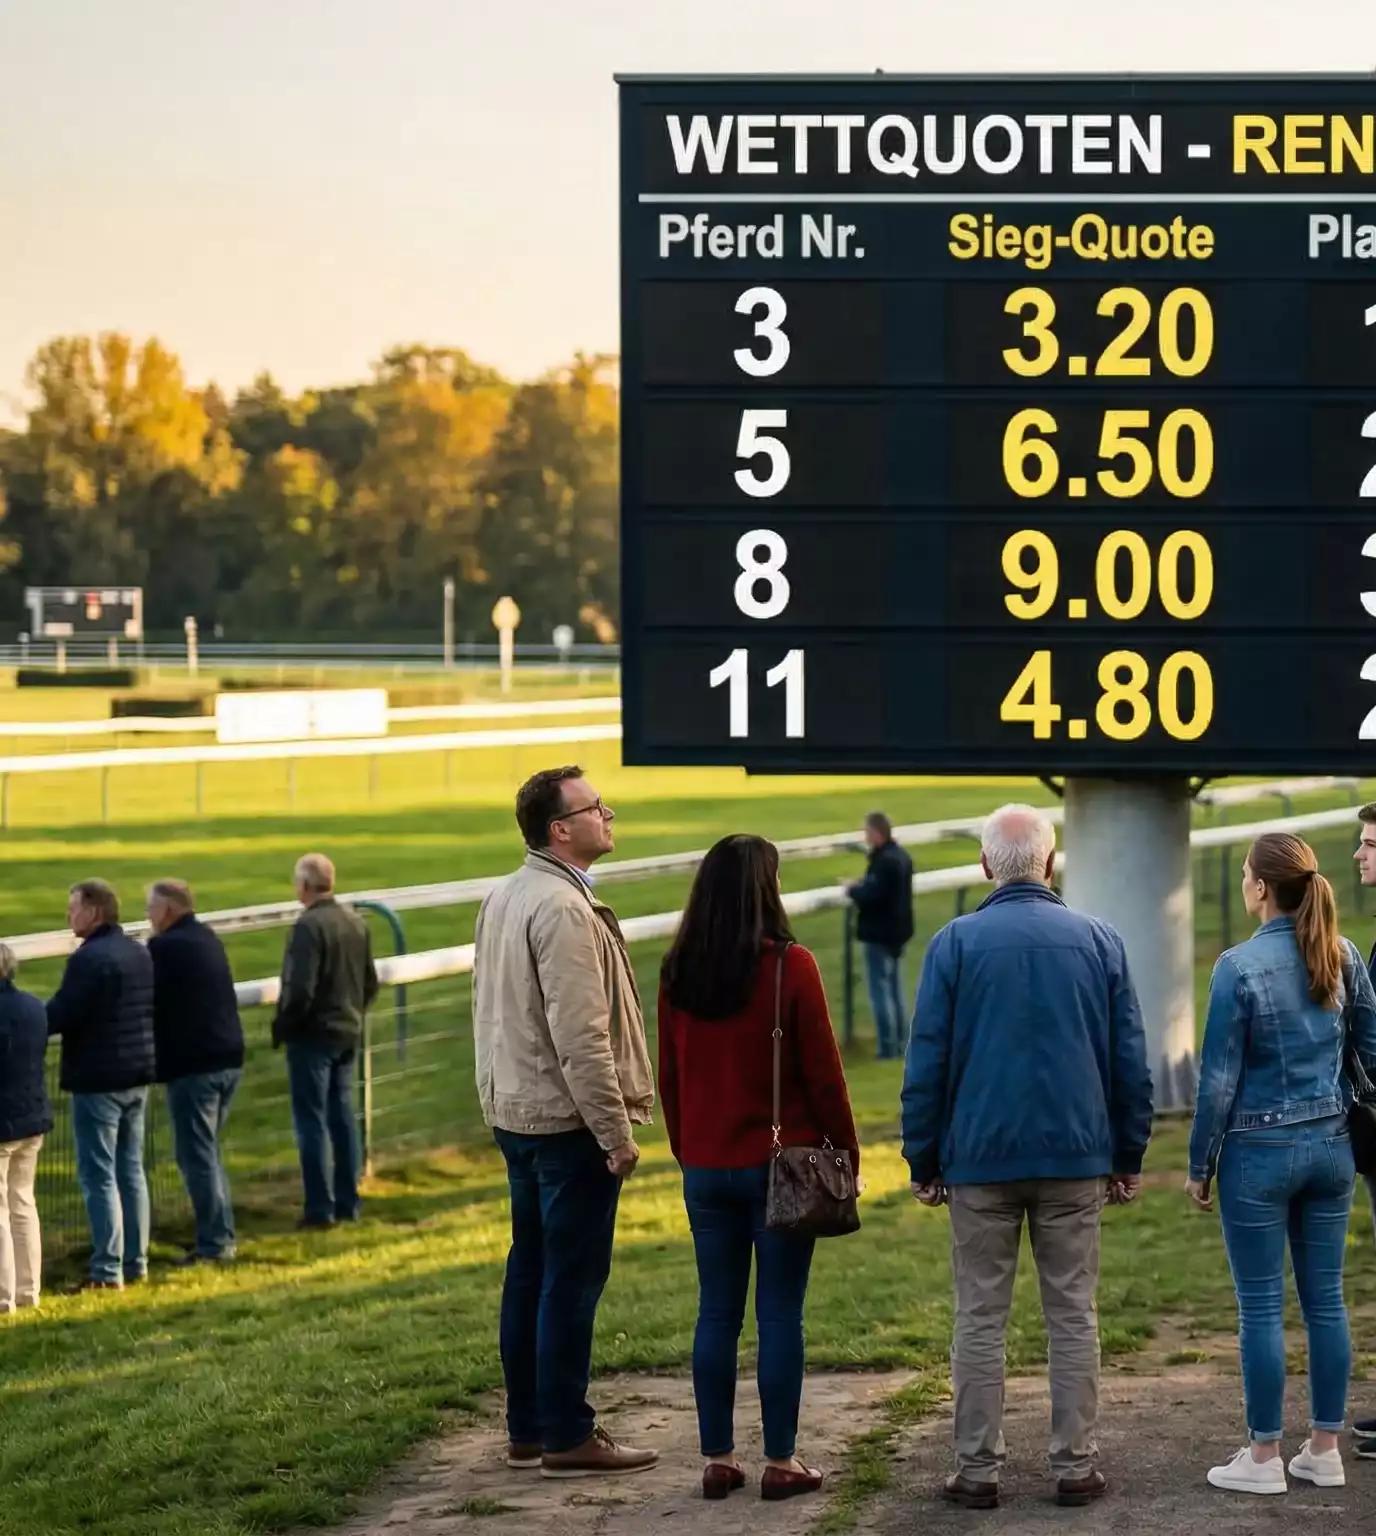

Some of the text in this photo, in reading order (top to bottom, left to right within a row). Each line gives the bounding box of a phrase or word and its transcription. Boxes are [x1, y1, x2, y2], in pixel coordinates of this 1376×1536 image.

[666, 115, 1161, 178] WETTQUOTEN
[1187, 144, 1211, 159] -
[660, 214, 783, 258] Pferd
[802, 214, 864, 258] Nr.
[949, 214, 1214, 269] Sieg-Quote
[734, 287, 790, 376] 3
[1003, 287, 1213, 376] 3.20
[735, 409, 790, 497] 5
[1003, 409, 1213, 497] 6.50
[734, 529, 789, 619] 8
[1002, 530, 1213, 619] 9.00
[710, 649, 804, 737] 11
[1001, 650, 1213, 740] 4.80
